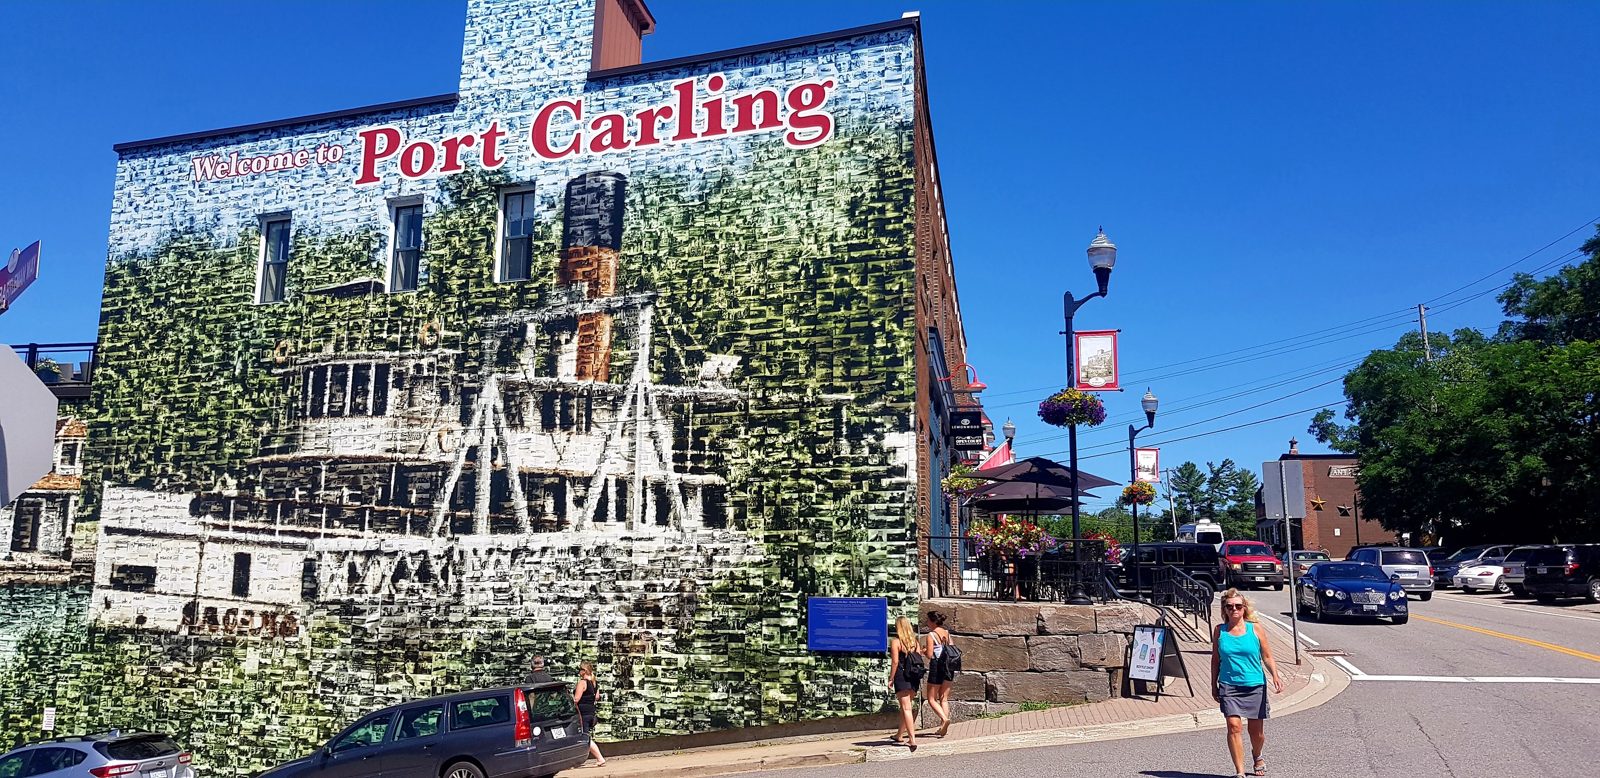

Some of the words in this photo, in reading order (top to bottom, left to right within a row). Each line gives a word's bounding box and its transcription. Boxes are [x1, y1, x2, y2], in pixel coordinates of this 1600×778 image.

[192, 149, 310, 182] Welcome
[316, 143, 345, 164] to
[355, 124, 506, 186] Port
[531, 75, 834, 159] Carling
